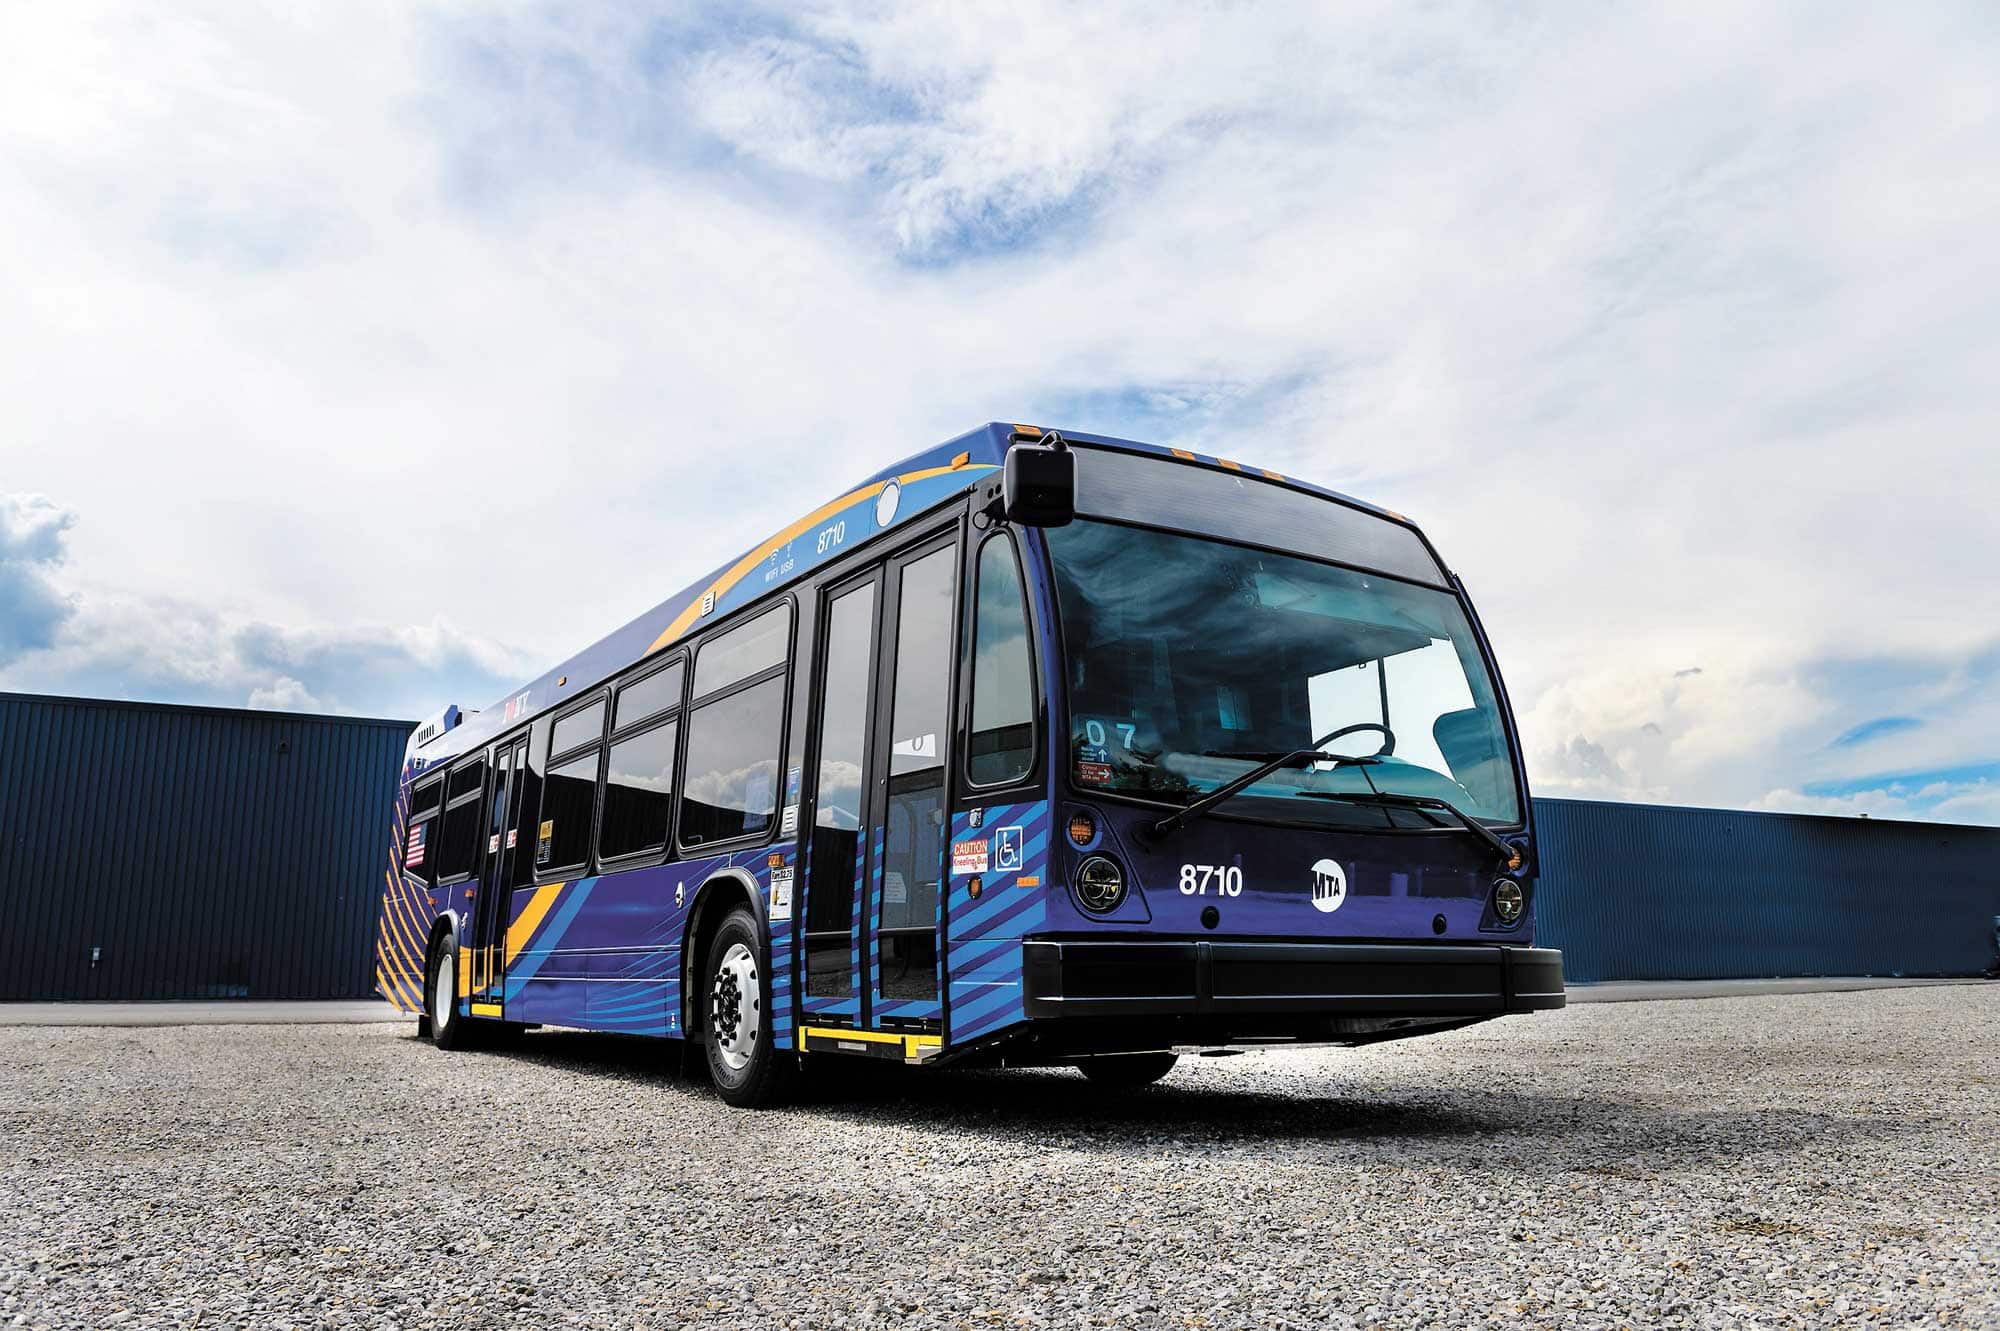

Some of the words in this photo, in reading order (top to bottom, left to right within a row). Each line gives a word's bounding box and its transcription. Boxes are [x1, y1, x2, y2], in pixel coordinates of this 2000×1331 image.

[817, 520, 845, 554] 8710
[780, 559, 794, 575] USB
[1116, 723, 1136, 749] 7
[954, 841, 988, 856] CAUTION
[1179, 864, 1243, 897] 8710
[1310, 871, 1341, 900] MTA
